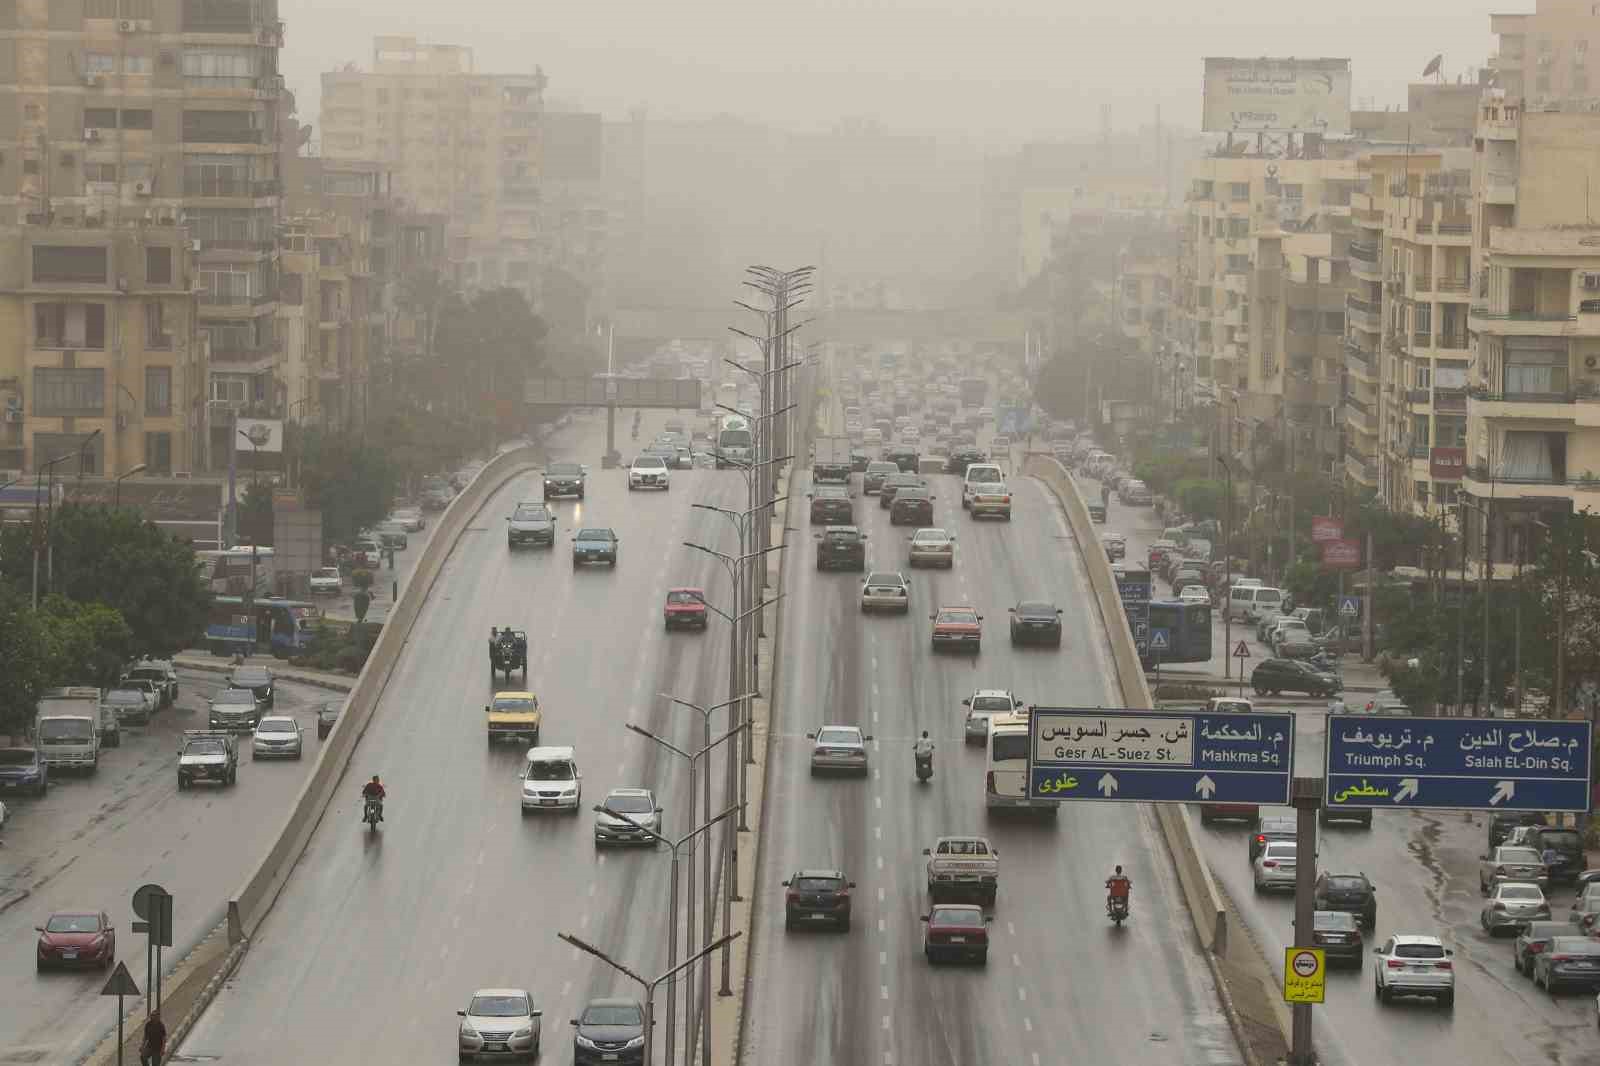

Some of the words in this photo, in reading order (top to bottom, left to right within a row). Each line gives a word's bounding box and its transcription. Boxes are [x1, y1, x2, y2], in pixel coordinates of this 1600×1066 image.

[1041, 720, 1108, 742] السويس
[1112, 725, 1151, 742] جسر
[1200, 720, 1262, 742] المحكمة
[1342, 727, 1412, 749] تريومف
[1459, 728, 1502, 750] الدين
[1054, 747, 1087, 760] Gesr
[1091, 747, 1150, 761] AL-Suez
[1156, 748, 1176, 761] St.
[1202, 750, 1258, 763] Mahkma
[1345, 752, 1401, 768] Triumph
[1404, 754, 1427, 769] Sq.
[1464, 755, 1502, 768] Salah
[1505, 757, 1548, 769] EL-Din
